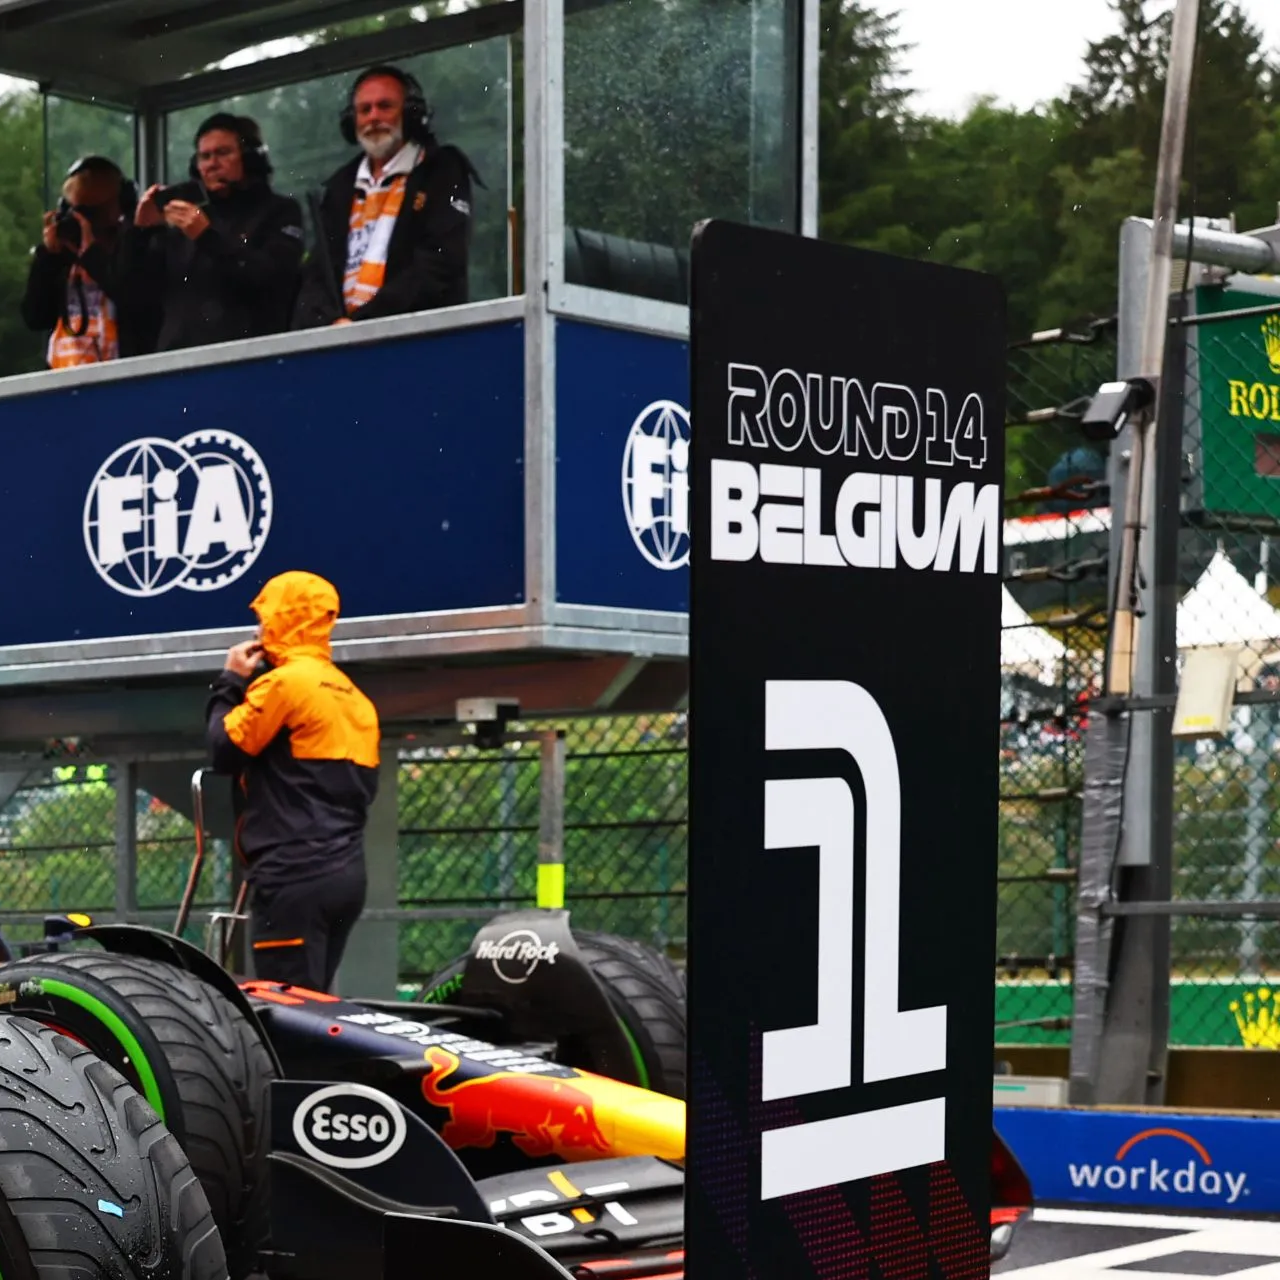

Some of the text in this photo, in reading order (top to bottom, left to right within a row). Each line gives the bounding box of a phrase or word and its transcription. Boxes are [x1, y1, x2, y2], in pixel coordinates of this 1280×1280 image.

[726, 362, 988, 470] ROUND 14
[710, 458, 1000, 575] BELGIUM
[762, 680, 948, 1102] 1
[312, 1104, 390, 1144] Esso
[1069, 1145, 1246, 1204] workday
